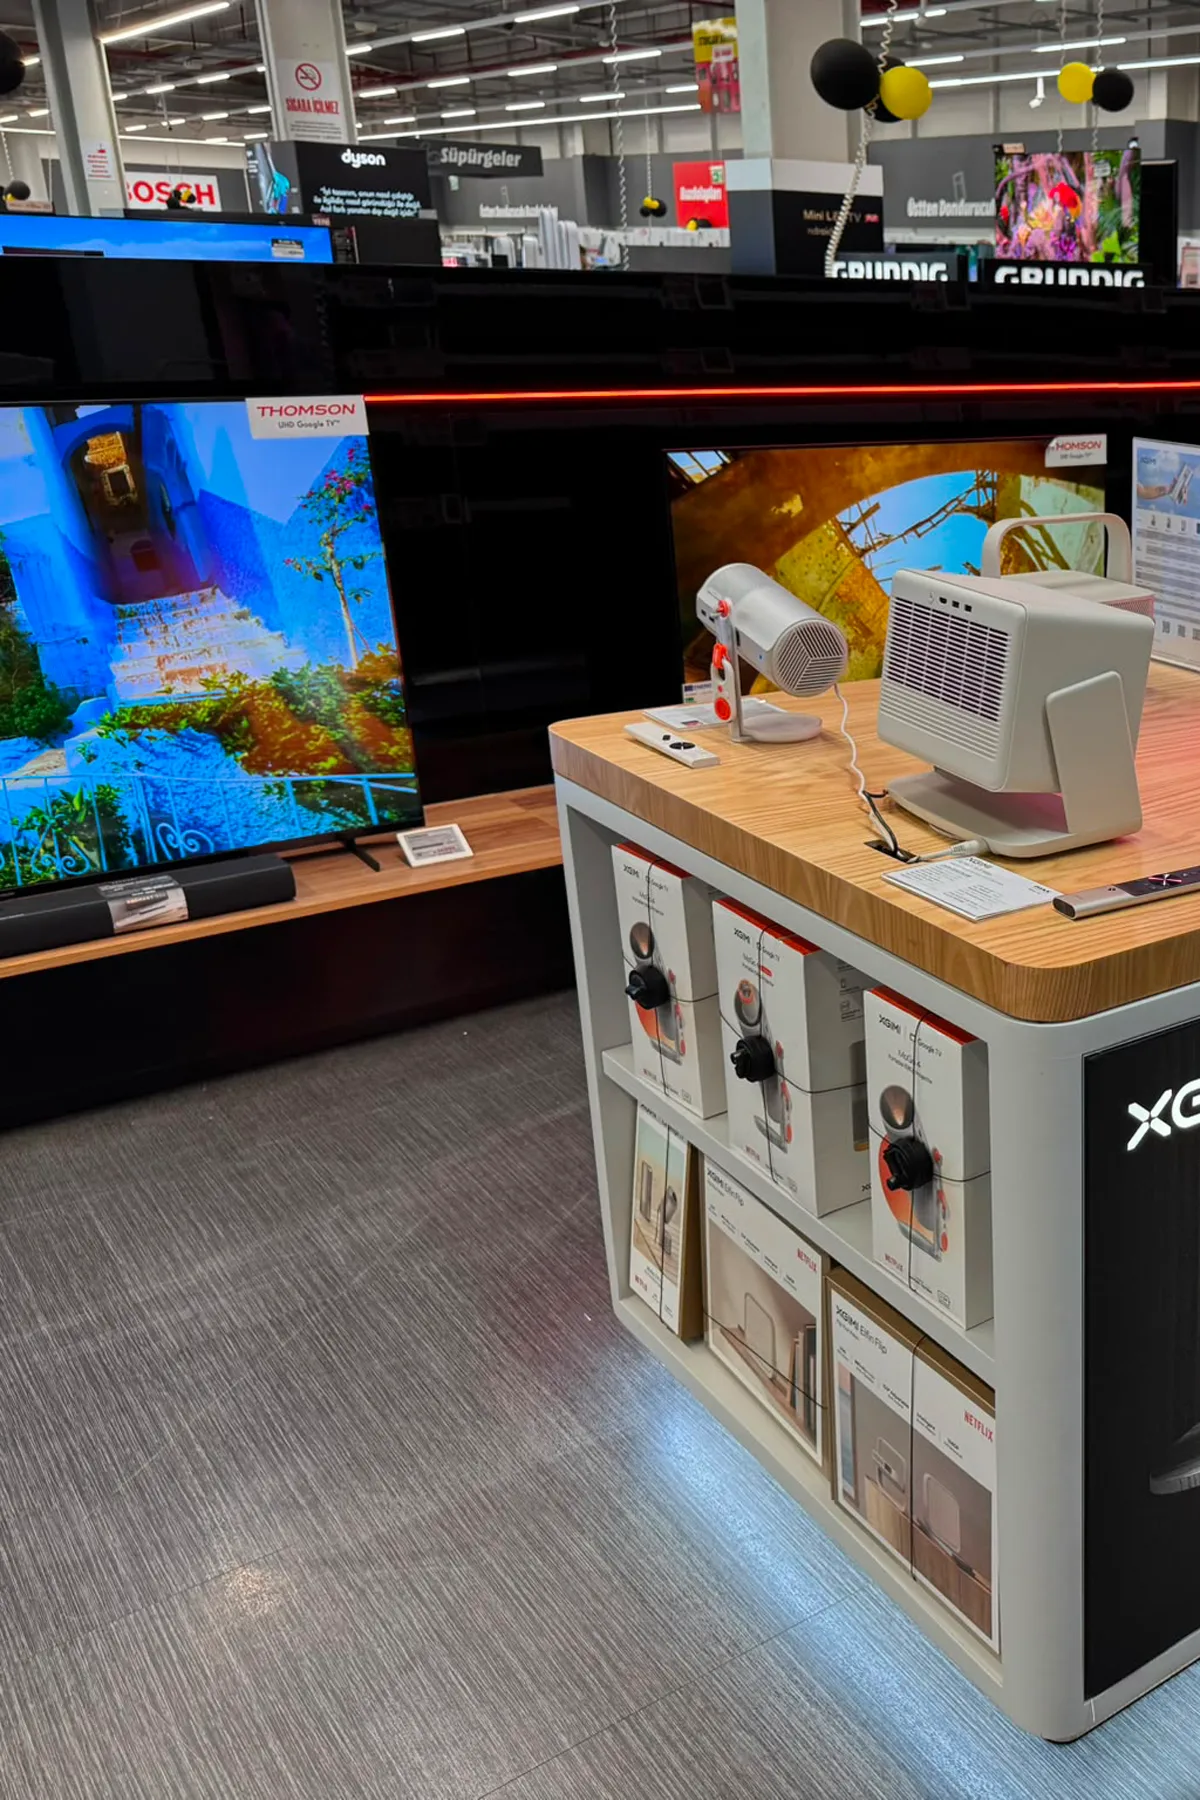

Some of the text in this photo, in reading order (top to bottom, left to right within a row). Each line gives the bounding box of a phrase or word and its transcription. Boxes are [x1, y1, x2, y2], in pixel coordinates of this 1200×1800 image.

[341, 148, 386, 168] dyson
[440, 147, 522, 168] Süpürgeler
[257, 404, 356, 417] THOMSON
[297, 420, 324, 429] Google
[1055, 441, 1102, 451] HOMSON
[964, 1410, 994, 1442] NETFLIX
